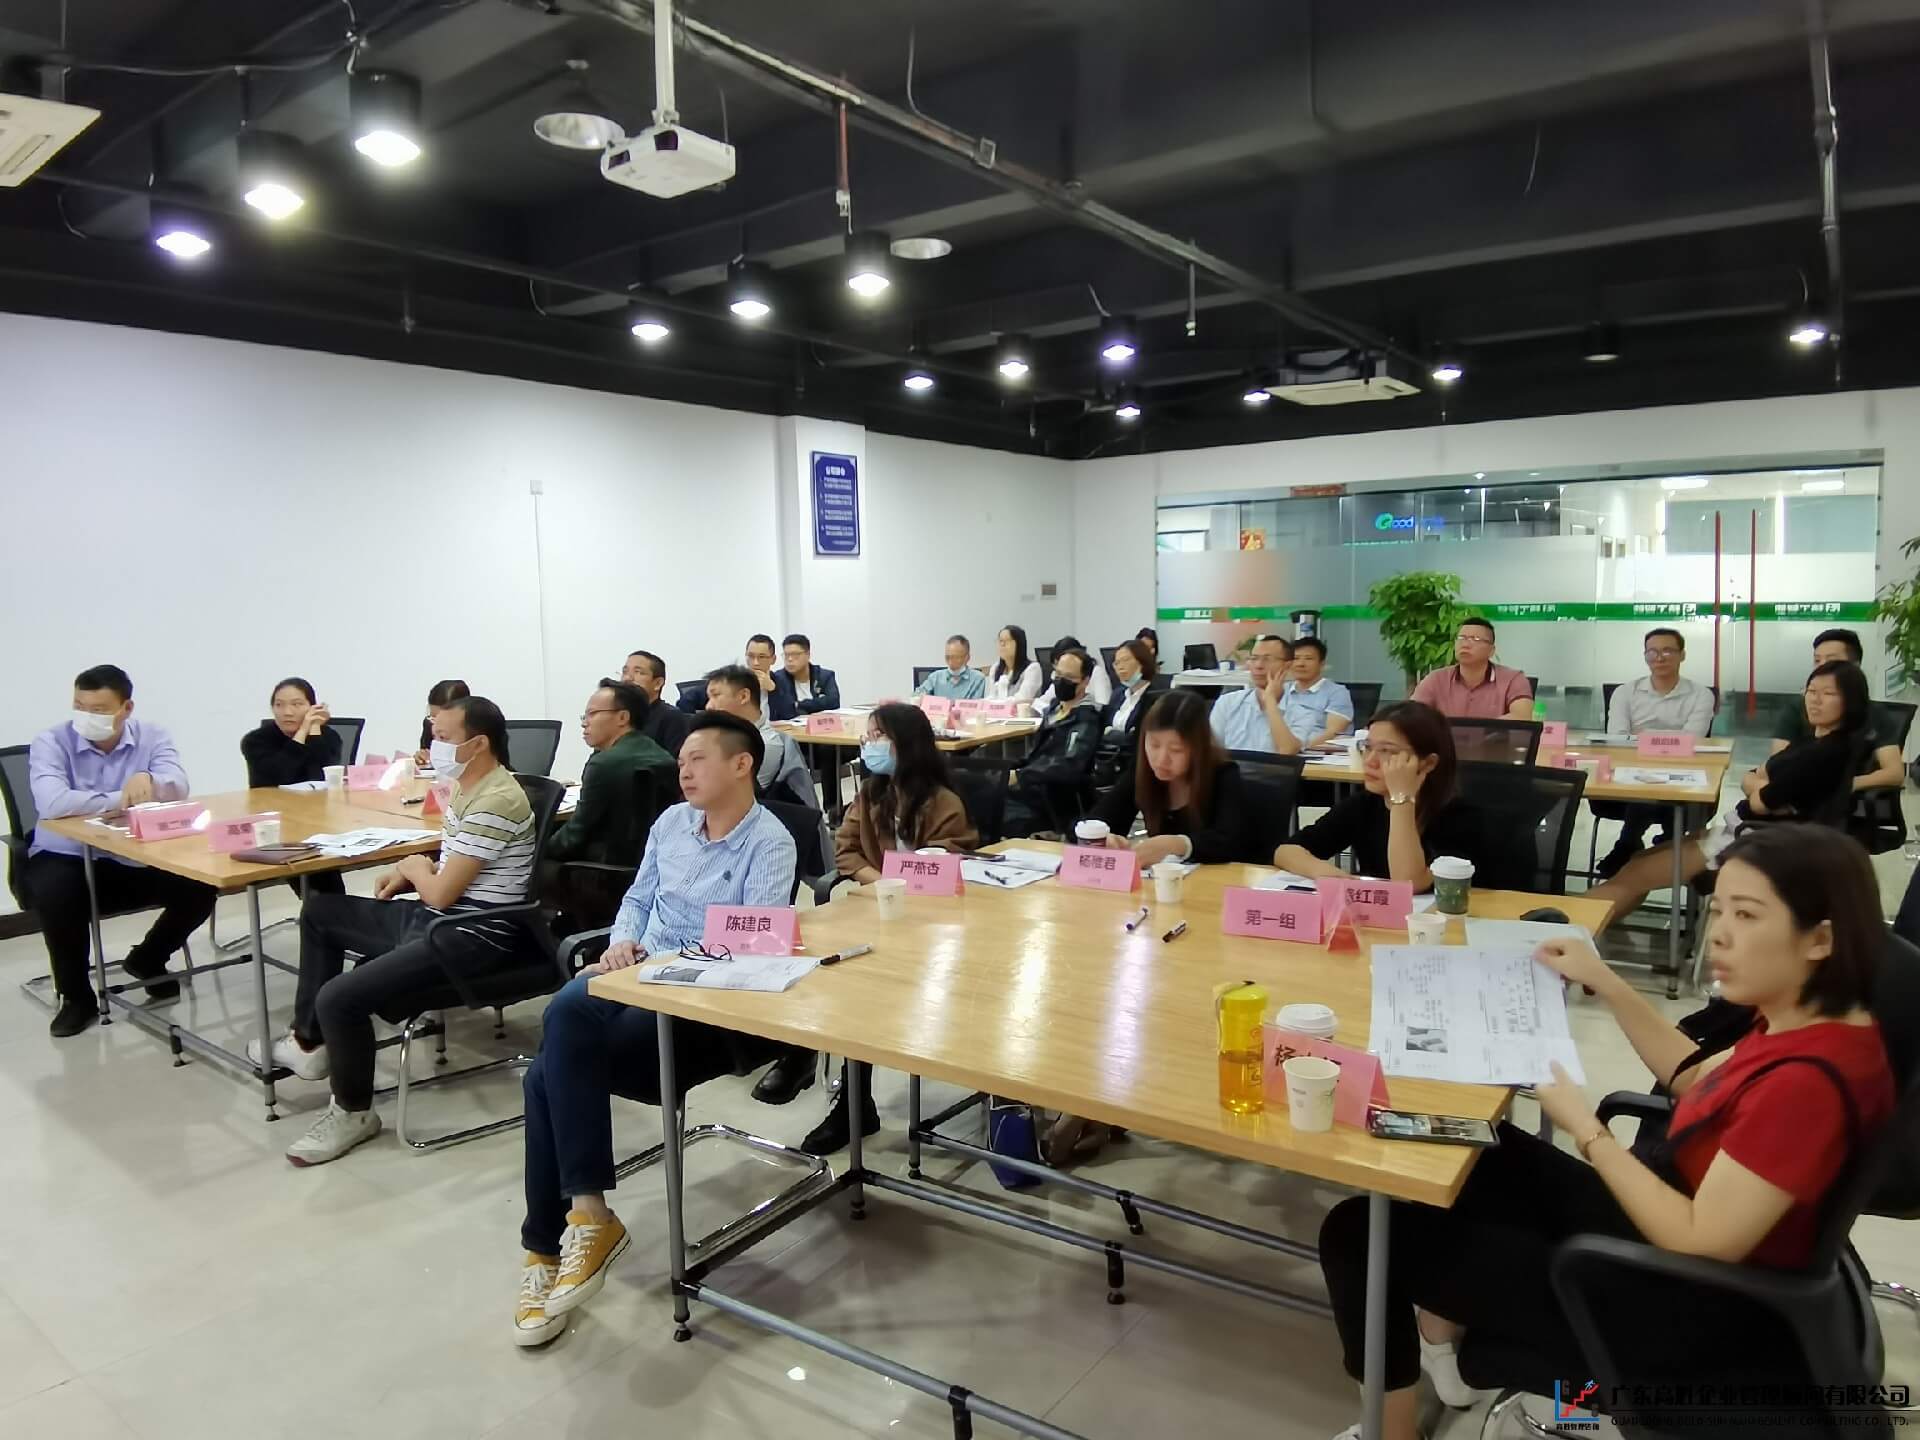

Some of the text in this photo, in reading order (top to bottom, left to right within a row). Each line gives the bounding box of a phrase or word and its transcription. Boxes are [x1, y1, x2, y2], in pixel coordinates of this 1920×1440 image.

[725, 914, 772, 933] 陈建良
[1245, 909, 1296, 929] 第一组
